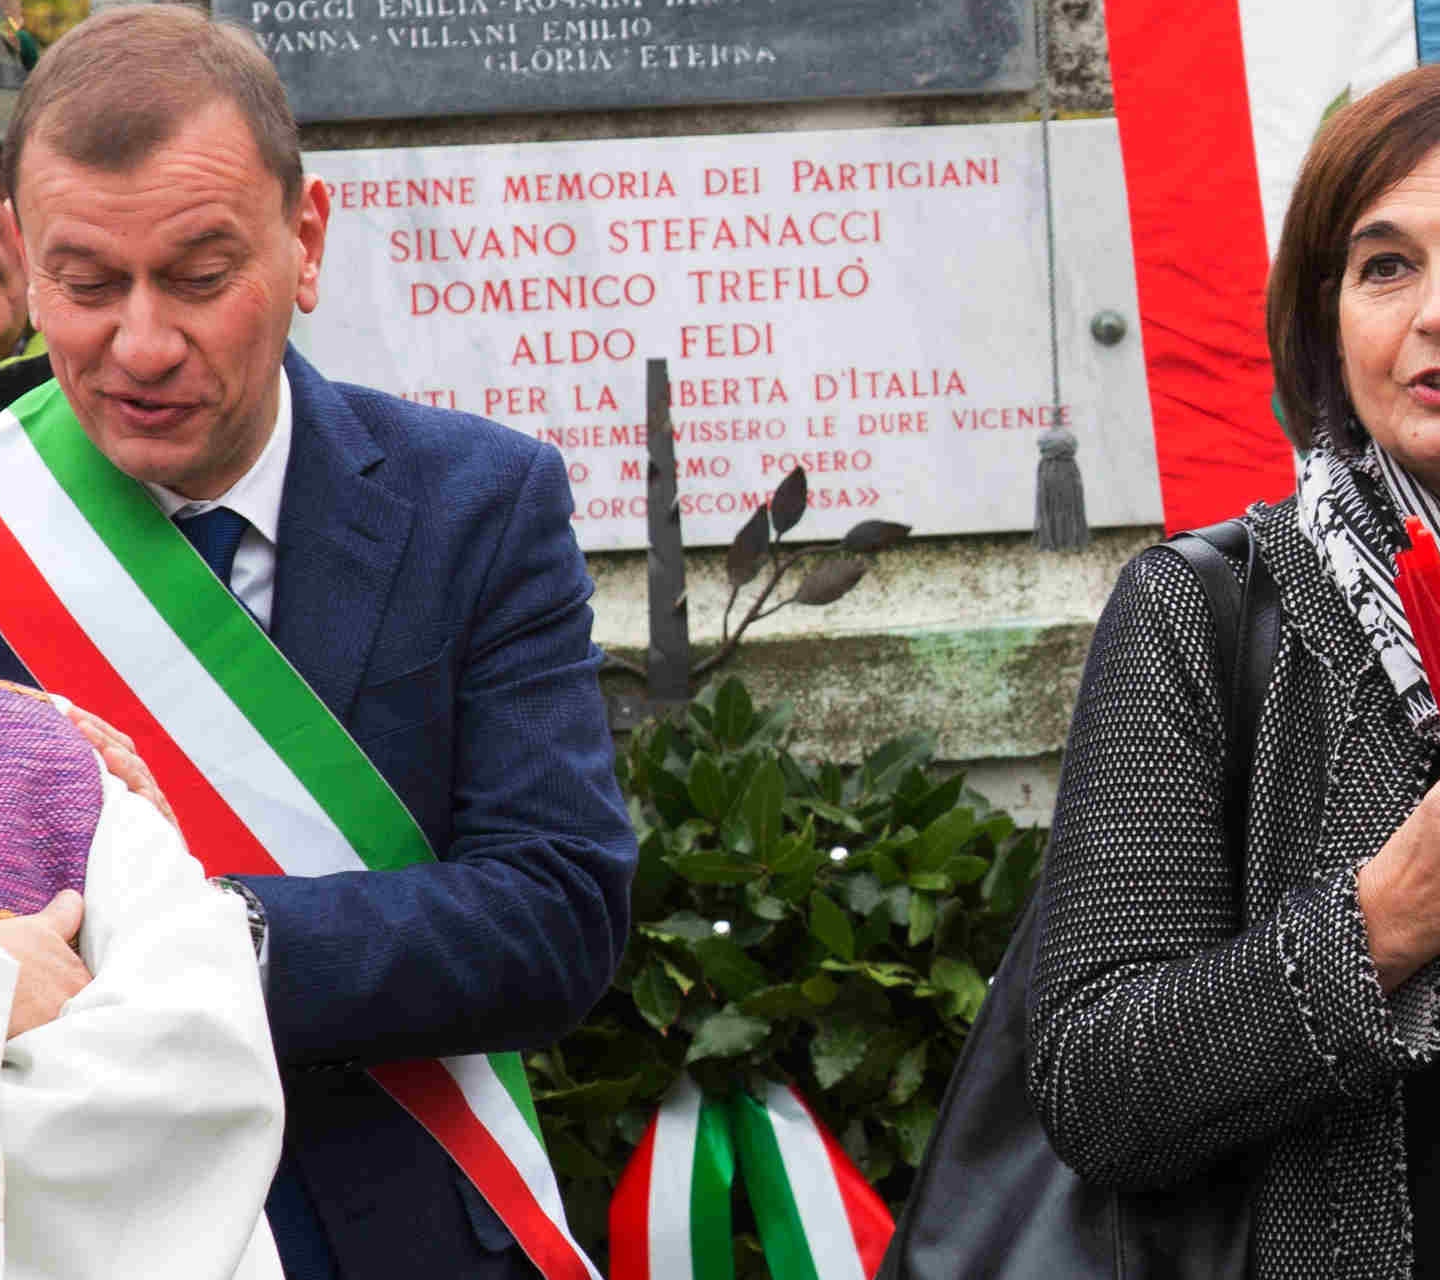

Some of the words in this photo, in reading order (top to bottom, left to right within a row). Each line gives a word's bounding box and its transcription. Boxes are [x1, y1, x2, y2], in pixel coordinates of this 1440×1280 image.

[387, 23, 517, 49] VILLANI
[541, 17, 652, 42] EMILIO
[484, 47, 613, 73] GLORIA
[640, 44, 777, 69] ETERNA
[503, 171, 677, 204] MEMORIA
[703, 166, 761, 197] DEI
[390, 223, 577, 264] SILVANO
[607, 210, 882, 255] STEFANACCI
[409, 273, 657, 318] DOMENICO
[511, 327, 637, 366] ALDO
[679, 321, 775, 360] FEDI
[483, 387, 548, 417] PER
[573, 384, 620, 412] LA
[666, 375, 789, 409] IBERTA
[813, 366, 967, 403] D'ITALIA
[807, 415, 837, 439] LE
[857, 410, 929, 437] DURE
[951, 404, 1073, 432] VICENDE
[760, 449, 873, 476] POSERO
